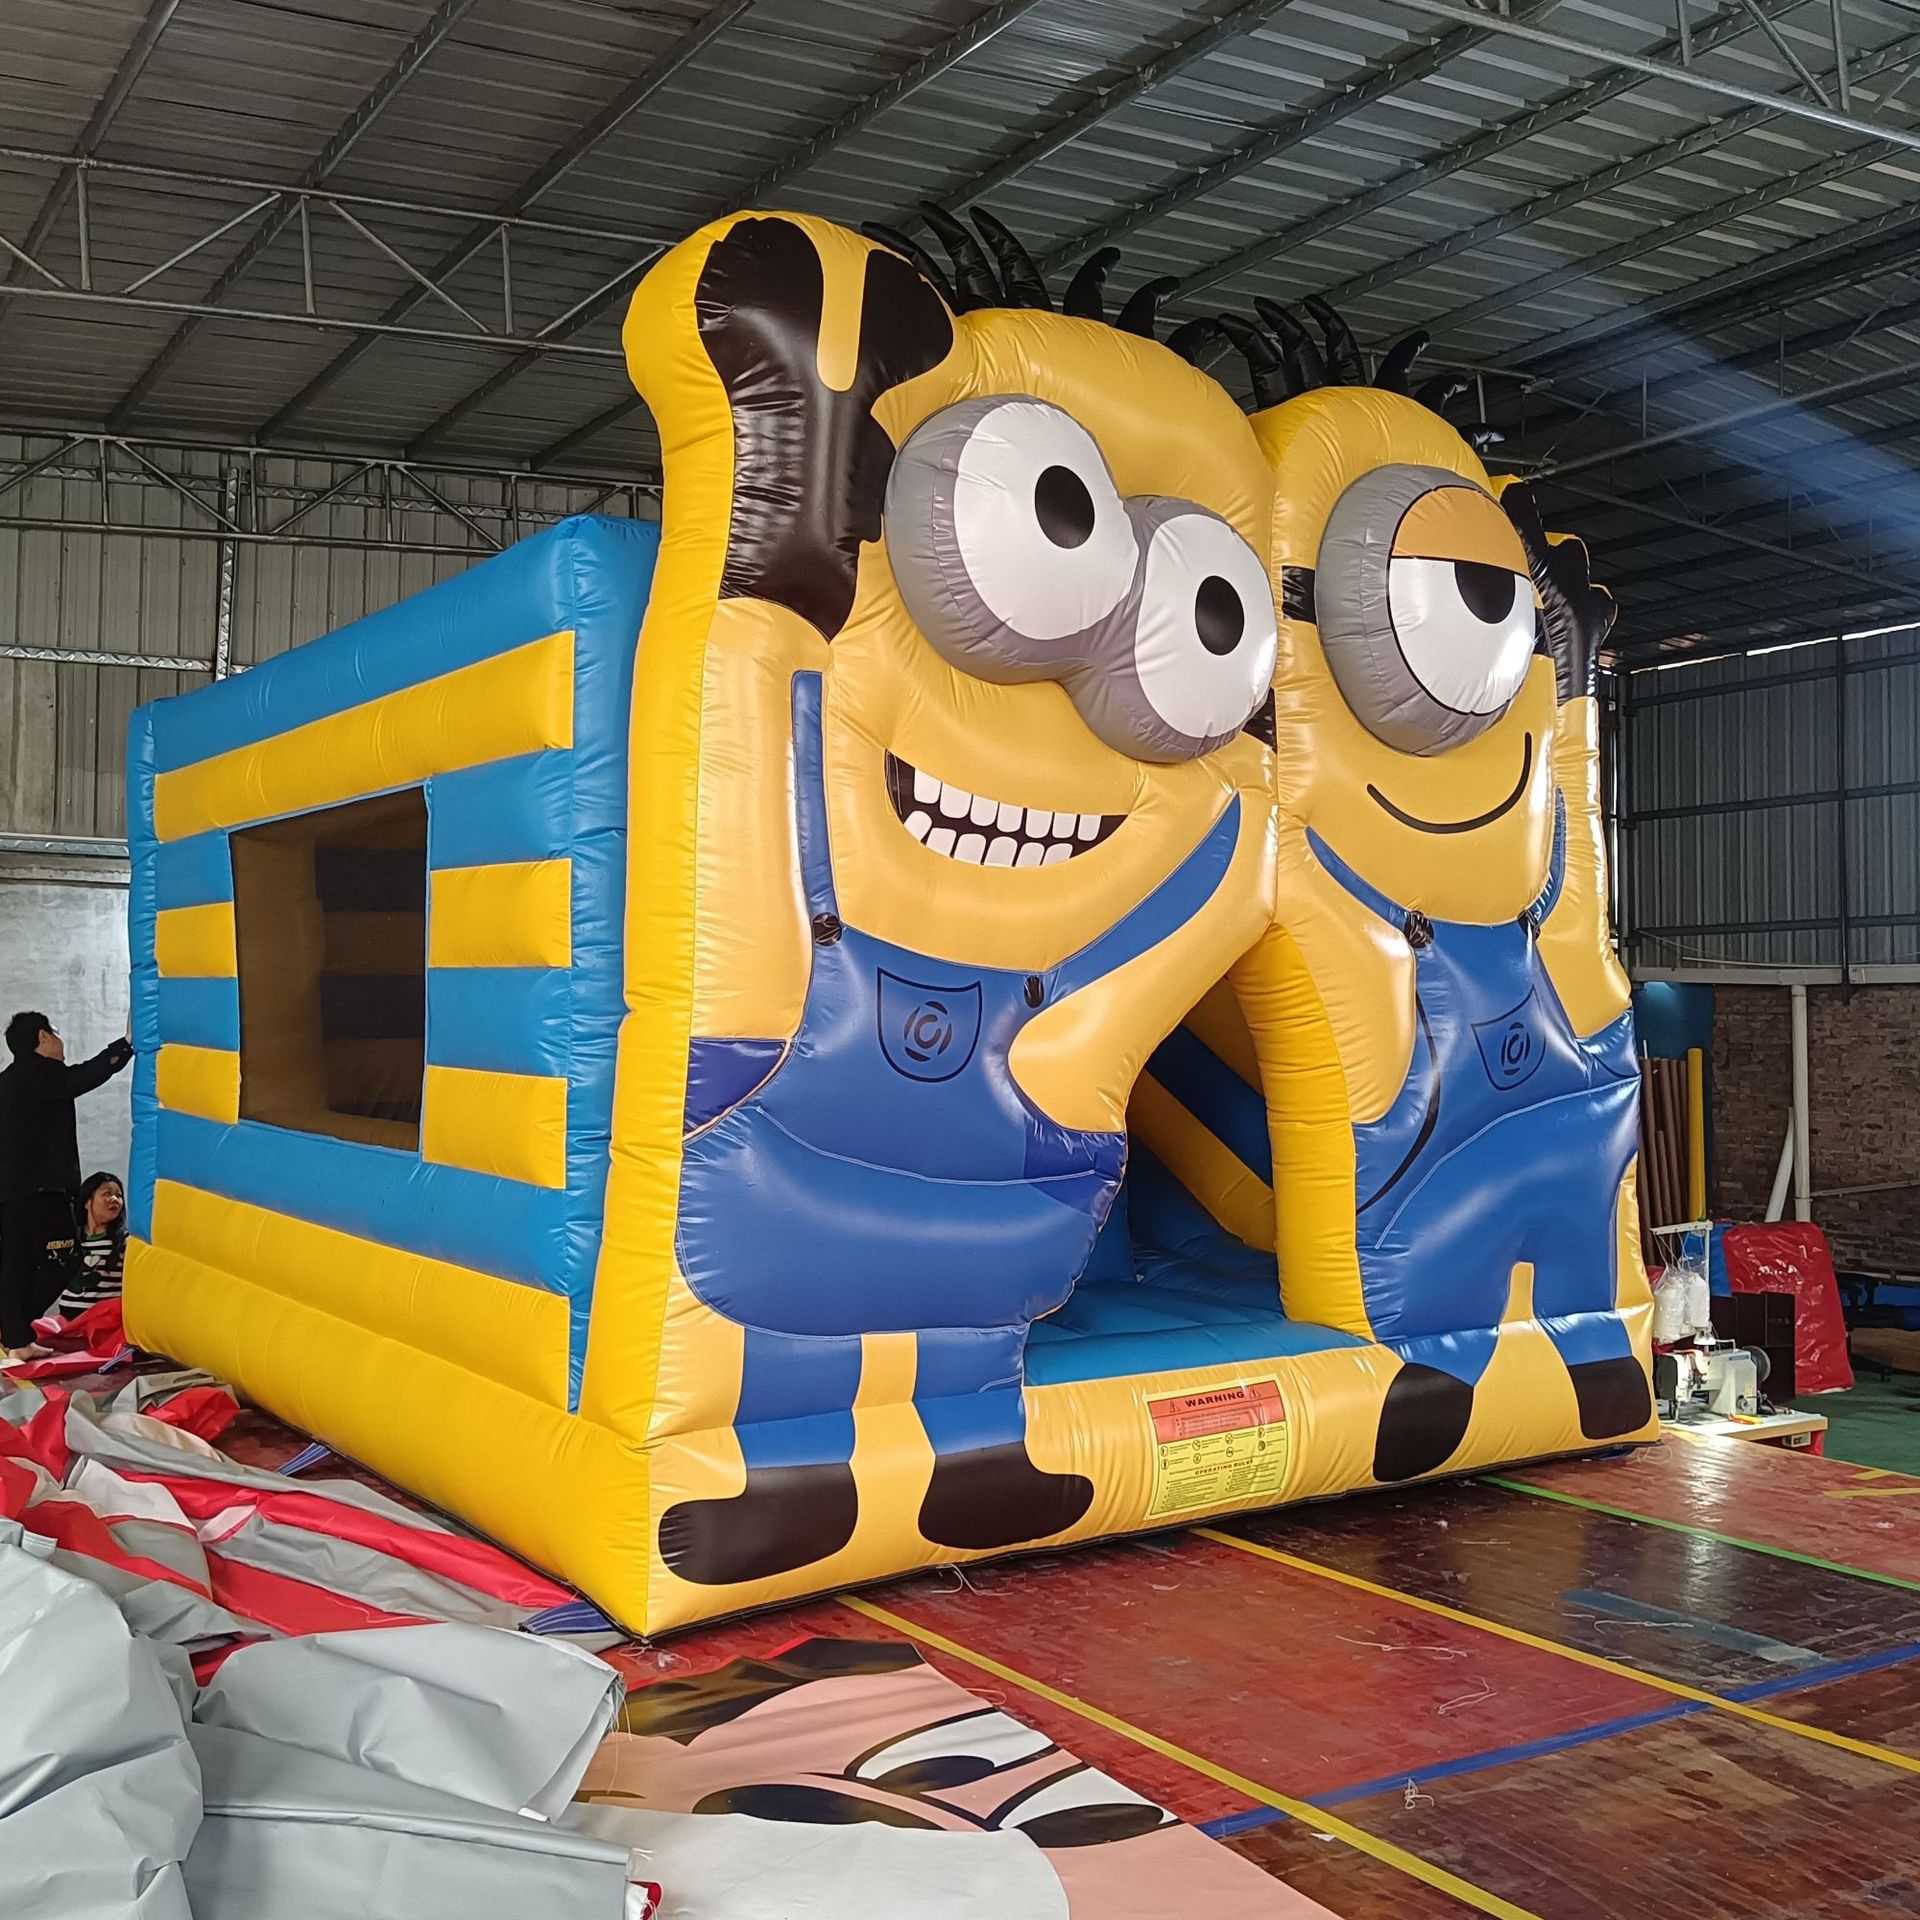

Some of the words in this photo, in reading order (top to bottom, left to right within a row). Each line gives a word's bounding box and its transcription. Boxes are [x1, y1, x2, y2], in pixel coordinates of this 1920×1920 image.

[1185, 1391, 1245, 1408] WARNING
[1194, 1463, 1233, 1475] OPERATING
[1233, 1458, 1253, 1468] RULES
